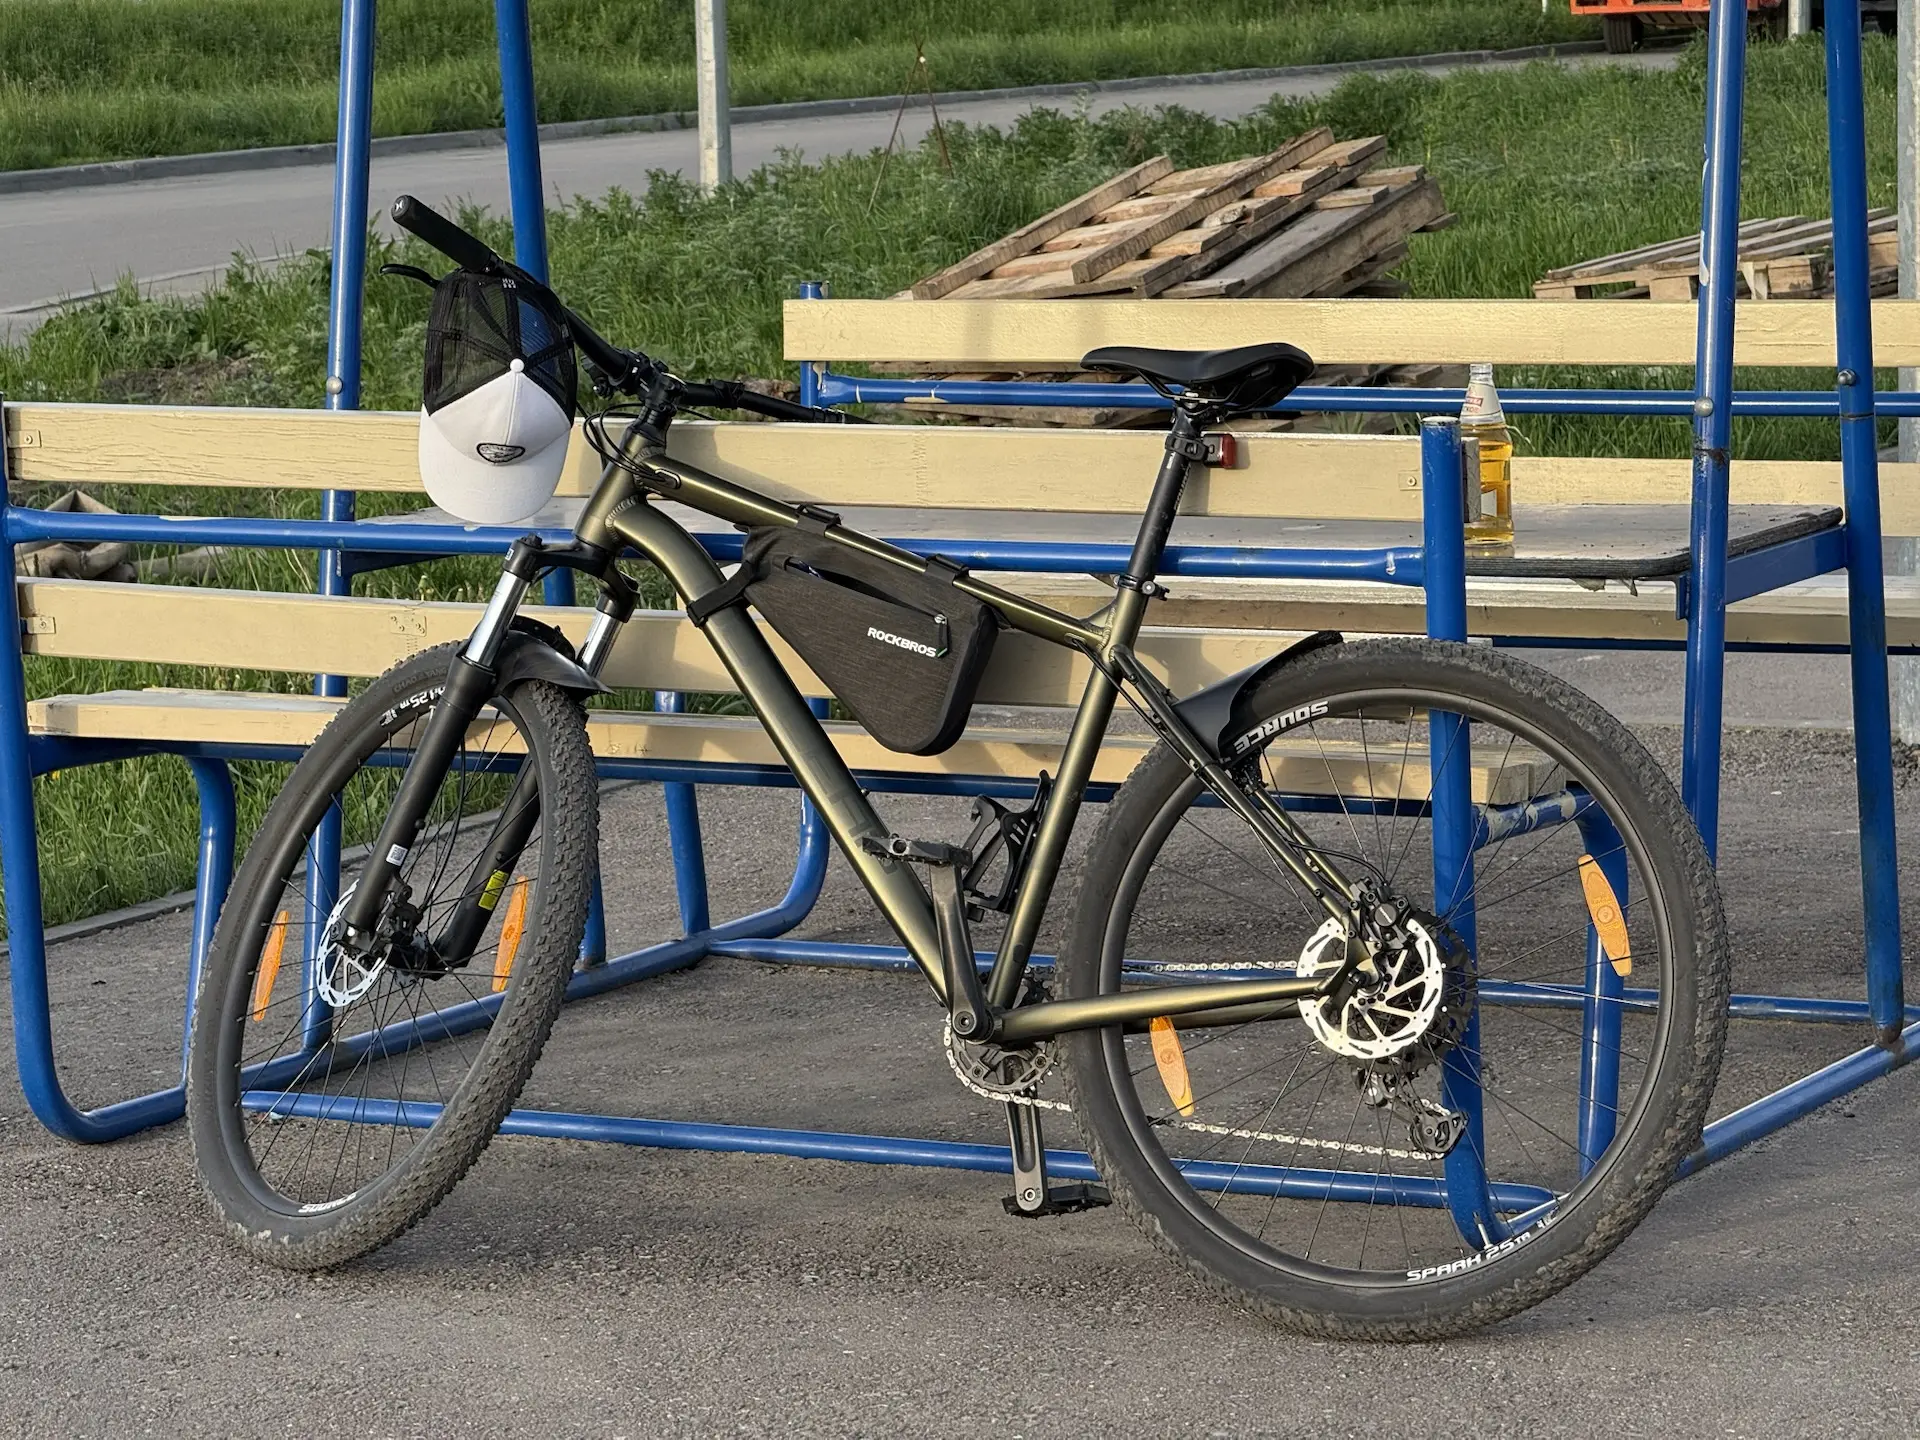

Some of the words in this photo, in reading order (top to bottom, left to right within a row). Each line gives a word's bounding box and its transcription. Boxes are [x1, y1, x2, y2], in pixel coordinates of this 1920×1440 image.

[867, 626, 937, 658] ROCKBROS
[1233, 700, 1329, 755] SOURCE
[1406, 1253, 1482, 1282] SPARK
